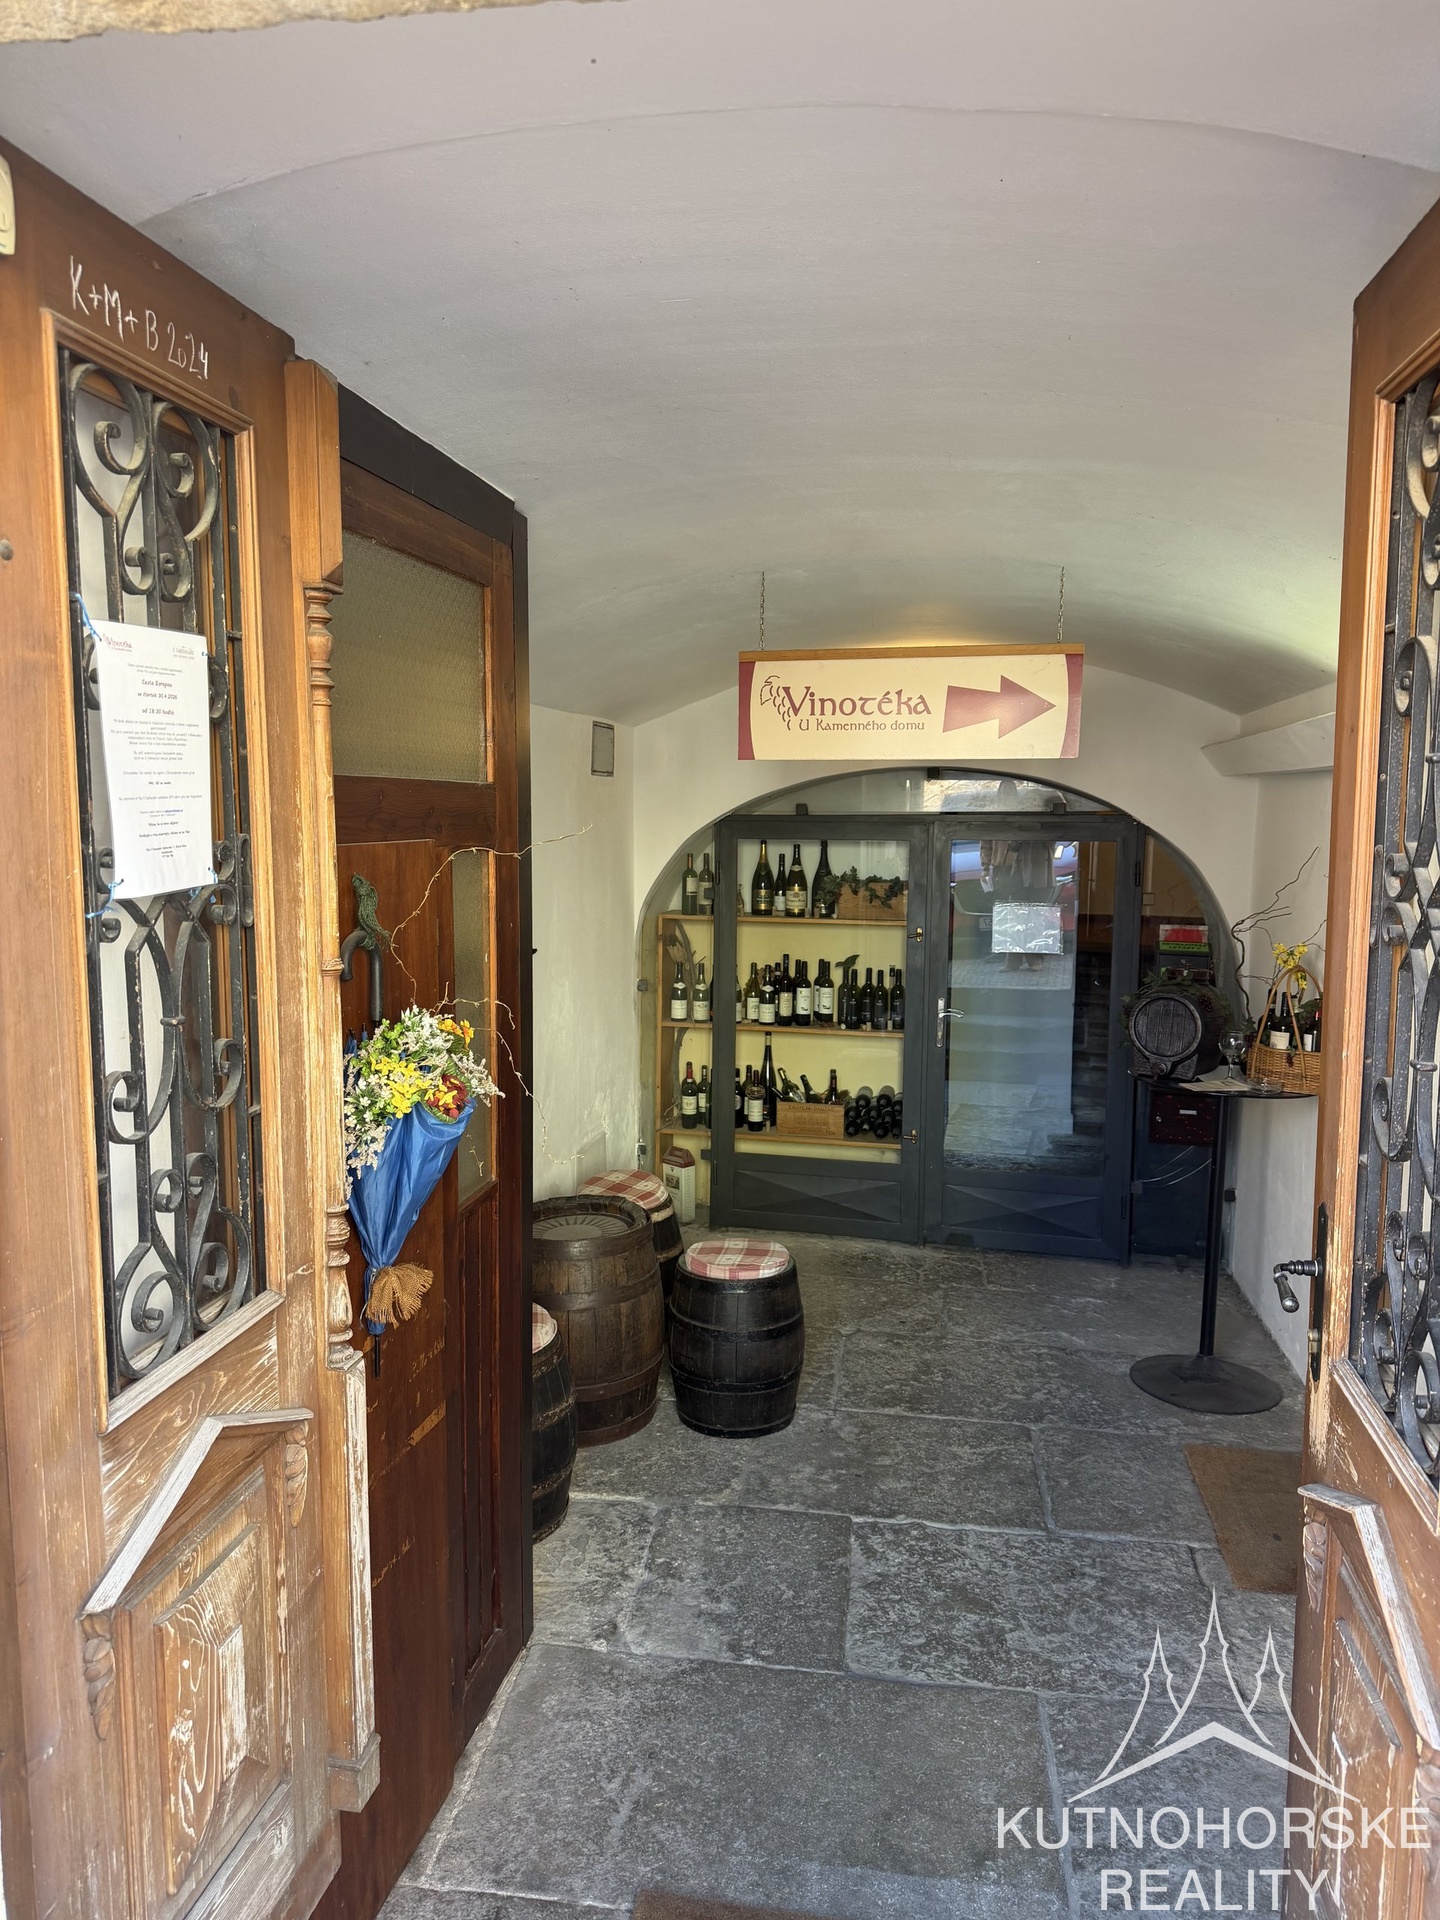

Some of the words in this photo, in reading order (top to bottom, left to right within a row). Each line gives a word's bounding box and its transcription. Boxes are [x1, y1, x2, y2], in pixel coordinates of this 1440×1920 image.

[167, 322, 208, 380] 2024
[782, 686, 932, 717] Vinotéka
[799, 718, 810, 731] U
[816, 718, 887, 732] Kamenného
[890, 719, 925, 731] domu
